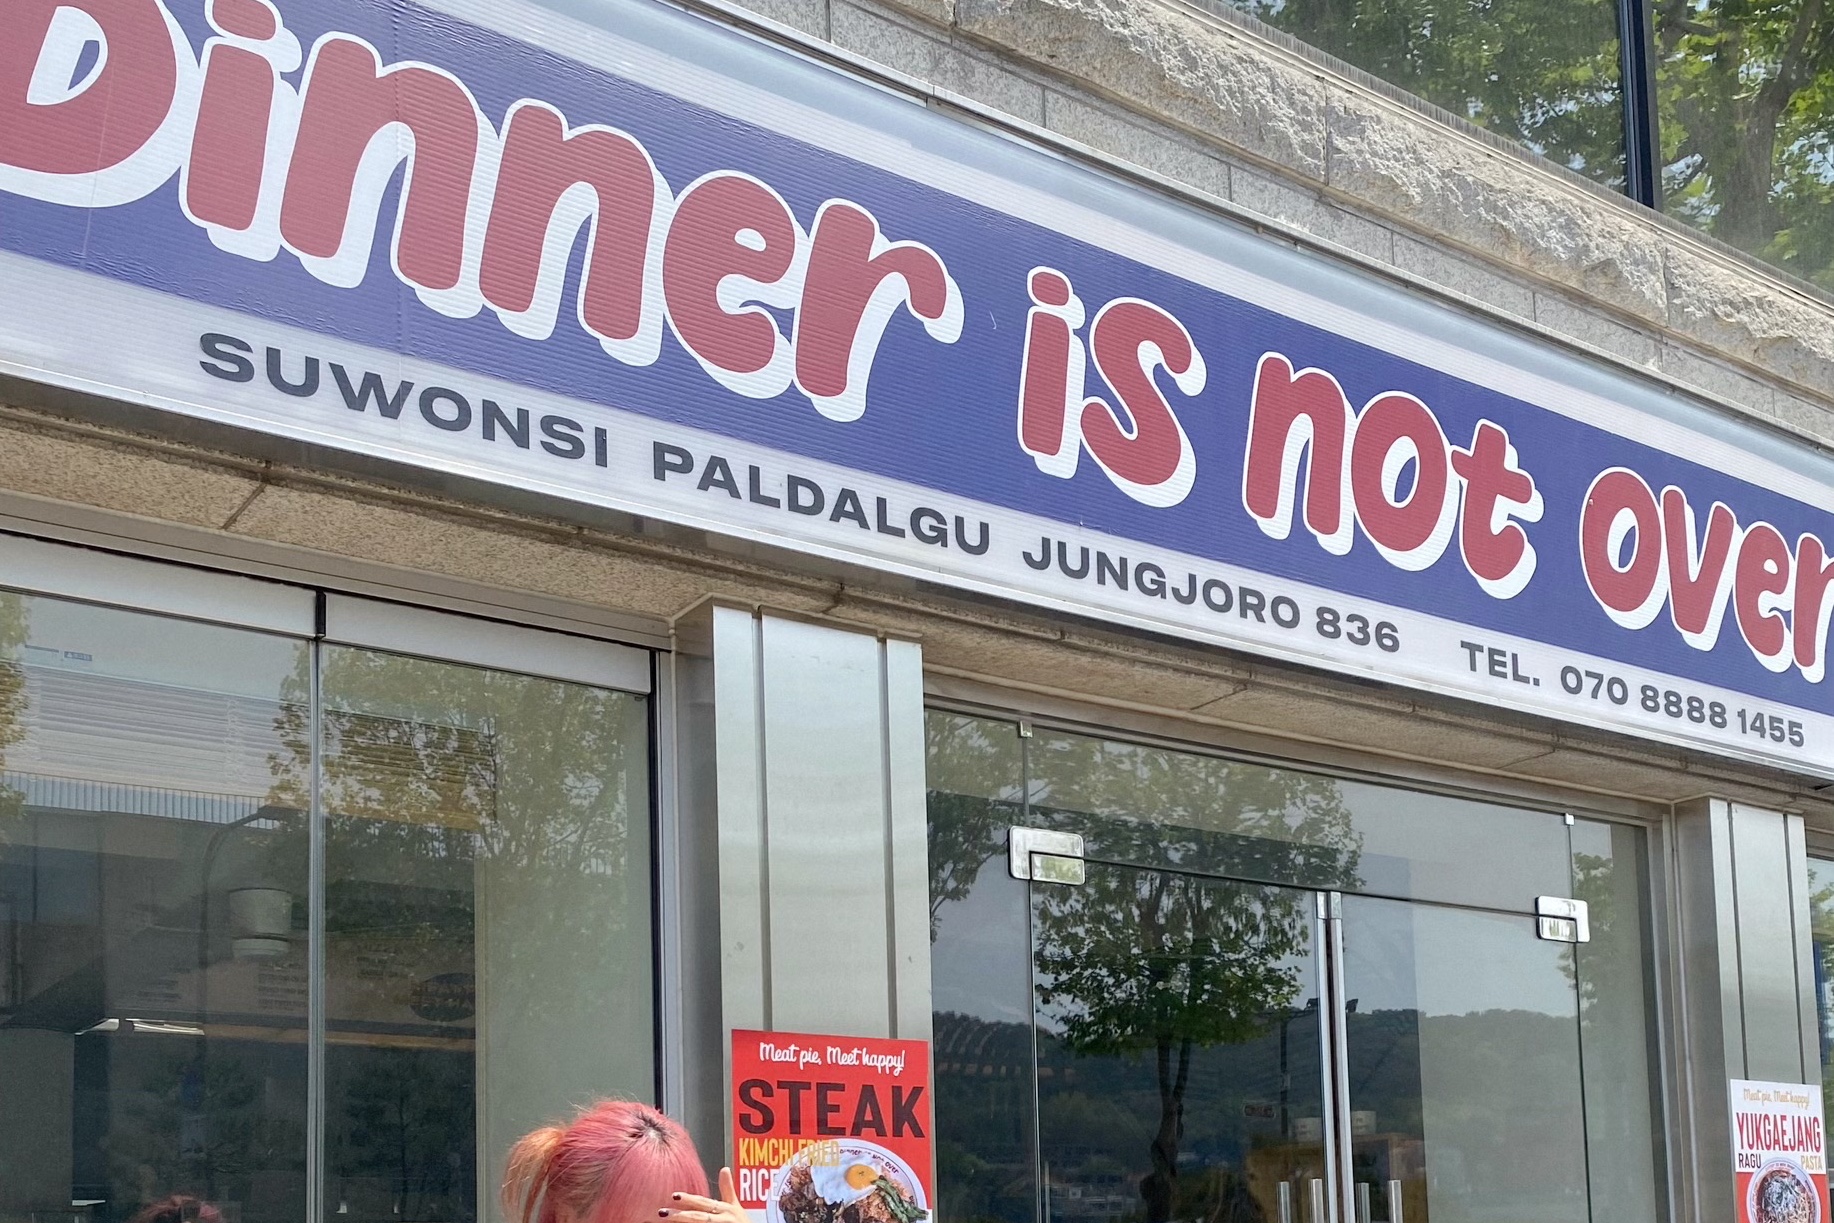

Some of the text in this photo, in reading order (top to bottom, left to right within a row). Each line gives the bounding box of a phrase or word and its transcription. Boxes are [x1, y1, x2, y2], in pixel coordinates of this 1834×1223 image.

[0, 0, 968, 425] Dinner
[1018, 265, 1206, 508] is
[1242, 351, 1545, 600] not
[199, 332, 1806, 748] SUWONSI PALDALGU JUNGJORO 836 TEL. 070 8888 1455
[759, 1042, 799, 1063] Meat
[827, 1046, 860, 1067] Meet
[862, 1047, 906, 1077] happy!
[738, 1078, 925, 1138] STEAK
[1736, 1112, 1821, 1153] YUKGAEJANG
[739, 1137, 840, 1166] KIMCHI FRIED
[1738, 1153, 1762, 1169] RAGU
[1801, 1155, 1823, 1171] PASTA
[739, 1168, 781, 1202] RICE
